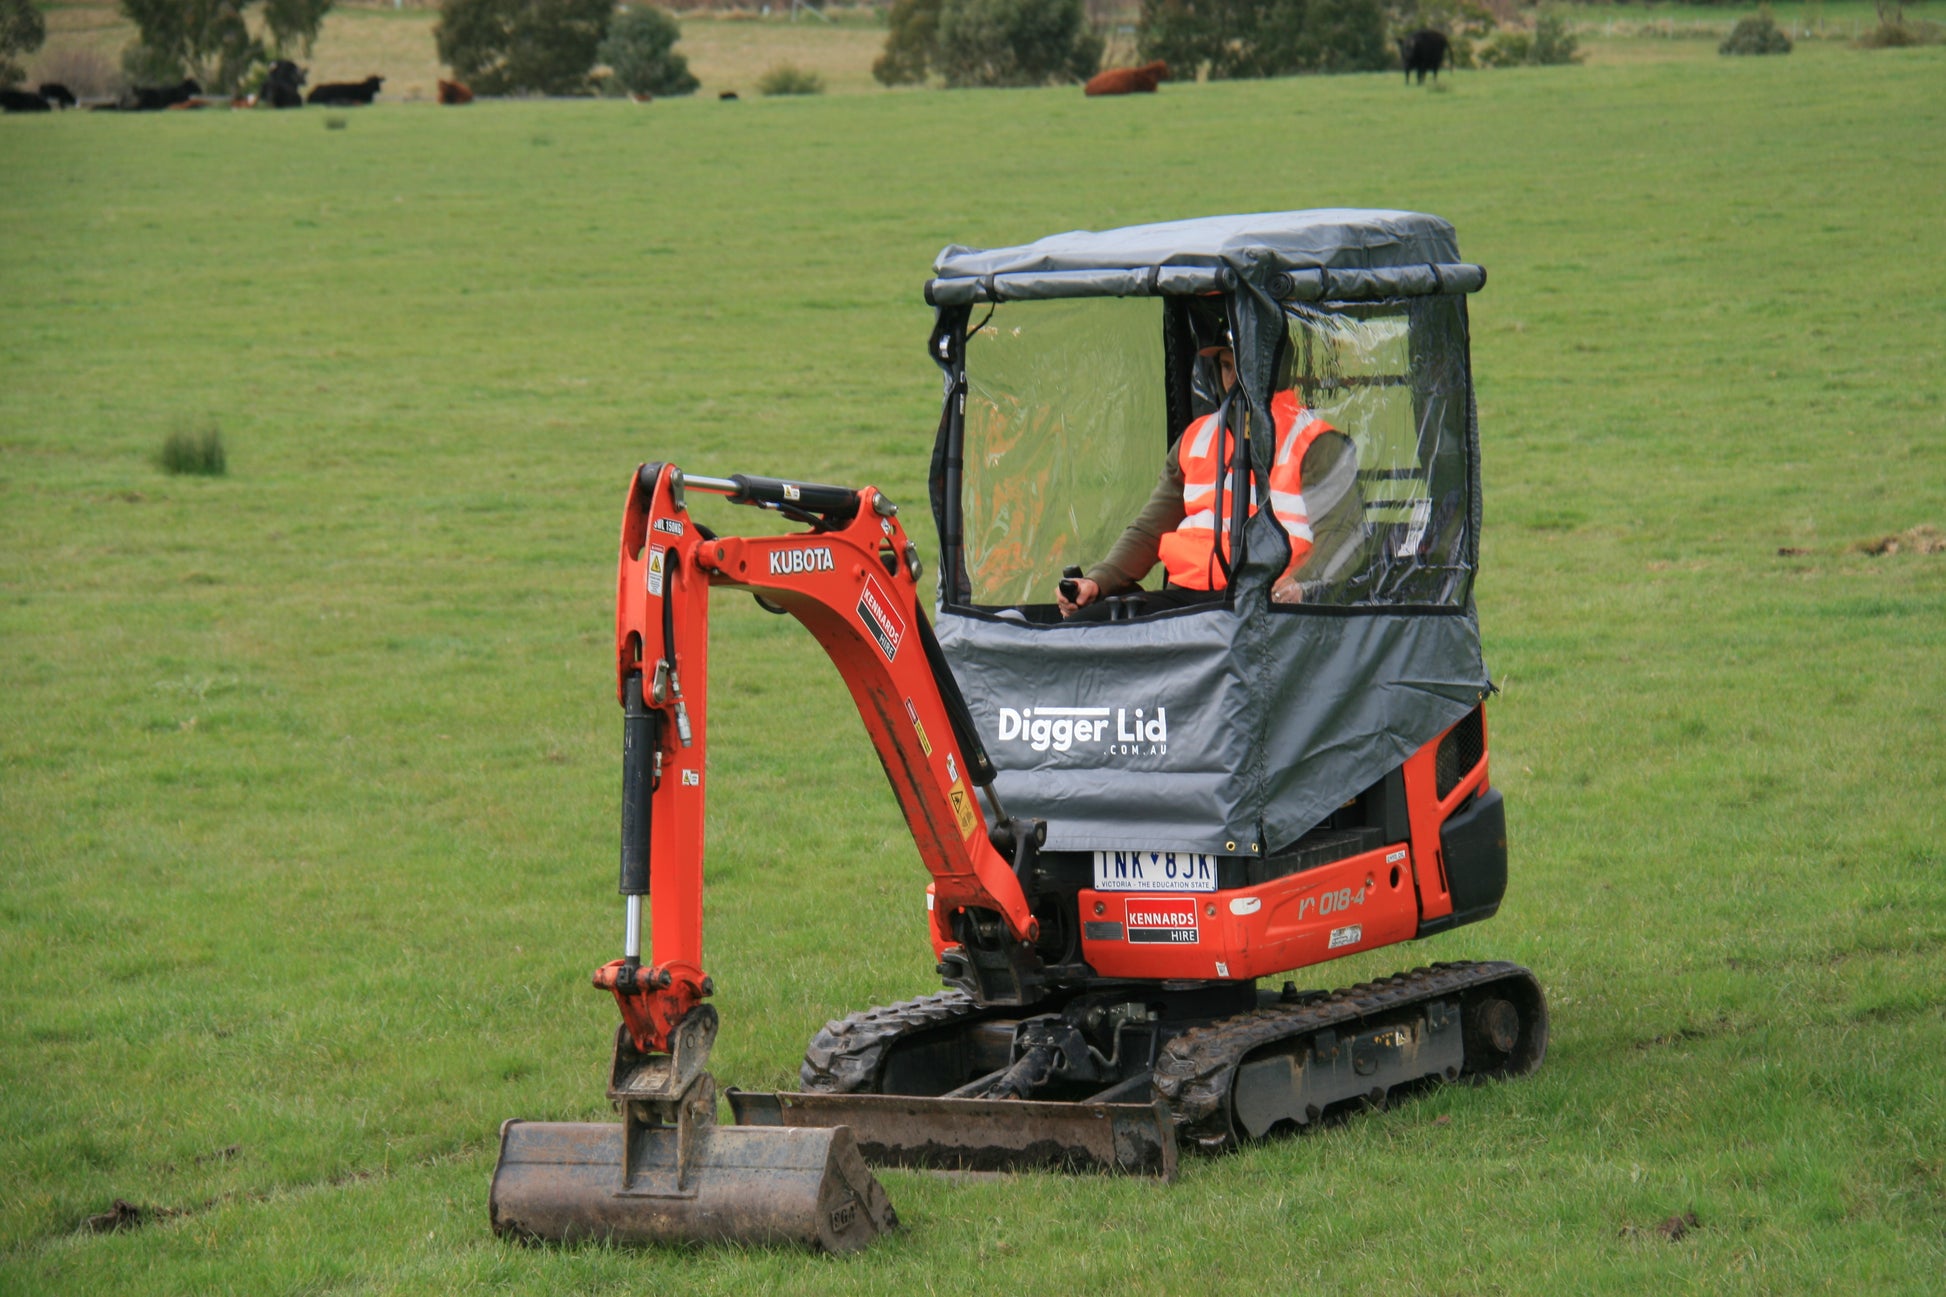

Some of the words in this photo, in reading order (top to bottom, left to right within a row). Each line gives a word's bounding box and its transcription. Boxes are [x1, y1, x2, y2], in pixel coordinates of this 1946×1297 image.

[769, 547, 835, 576] KUBOTA
[863, 588, 900, 644] KENNARDS
[878, 633, 895, 659] HIRE
[999, 707, 1110, 752] Digger
[1117, 707, 1168, 742] Lid
[1103, 745, 1168, 756] .COM.AU
[1152, 881, 1190, 889] EDUCATION
[1190, 881, 1210, 889] STATE
[1129, 912, 1195, 926] KENNARDS
[1171, 930, 1195, 942] HIRE
